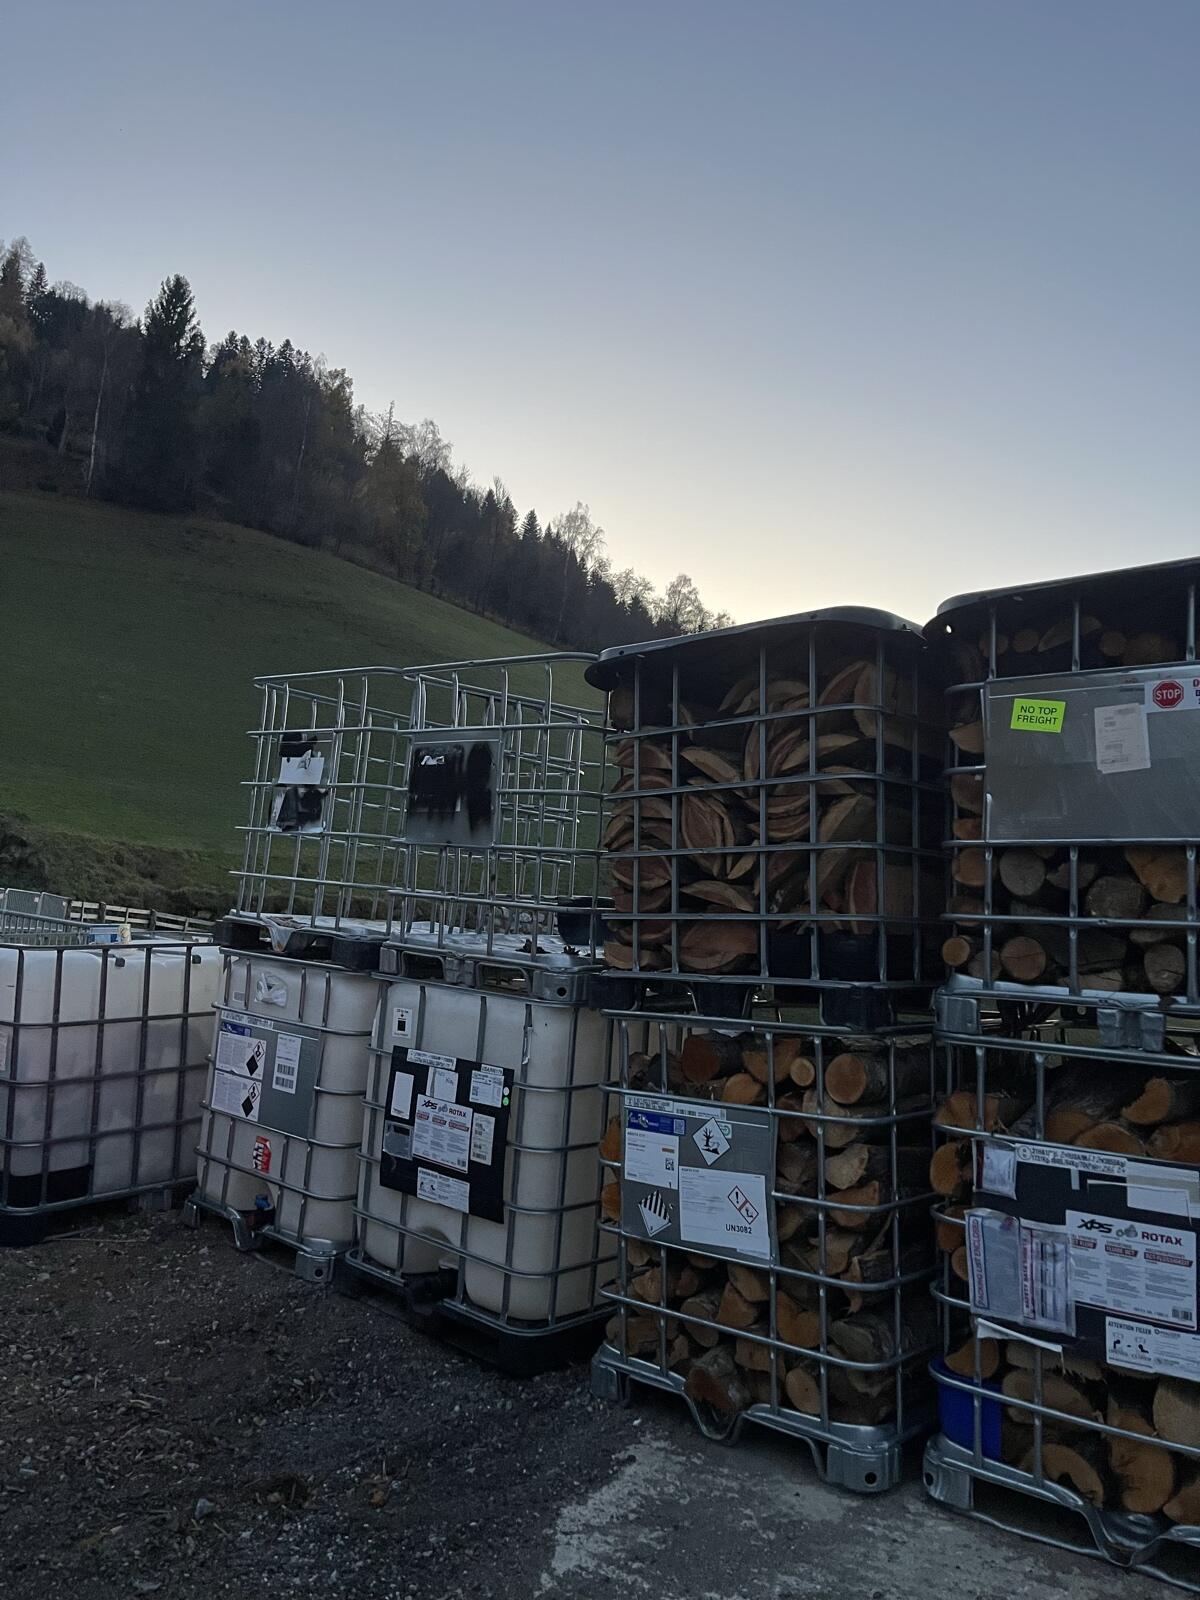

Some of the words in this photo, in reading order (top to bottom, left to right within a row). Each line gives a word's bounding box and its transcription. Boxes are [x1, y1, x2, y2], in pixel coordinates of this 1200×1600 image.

[1156, 688, 1181, 700] STOP
[1020, 705, 1035, 714] NO
[1038, 706, 1057, 716] TOP
[1017, 714, 1059, 725] FREIGHT
[421, 1099, 438, 1110] XPS
[448, 1107, 467, 1118] ROTAX
[725, 1223, 753, 1235] UN3082
[1077, 1218, 1114, 1234] XPS
[1141, 1231, 1184, 1247] ROTAX
[972, 1218, 982, 1258] ENCLOSED
[975, 1258, 984, 1274] LIST
[976, 1275, 986, 1306] PACKING
[1108, 1320, 1134, 1332] ATTENTION
[1135, 1326, 1152, 1336] FILLER
